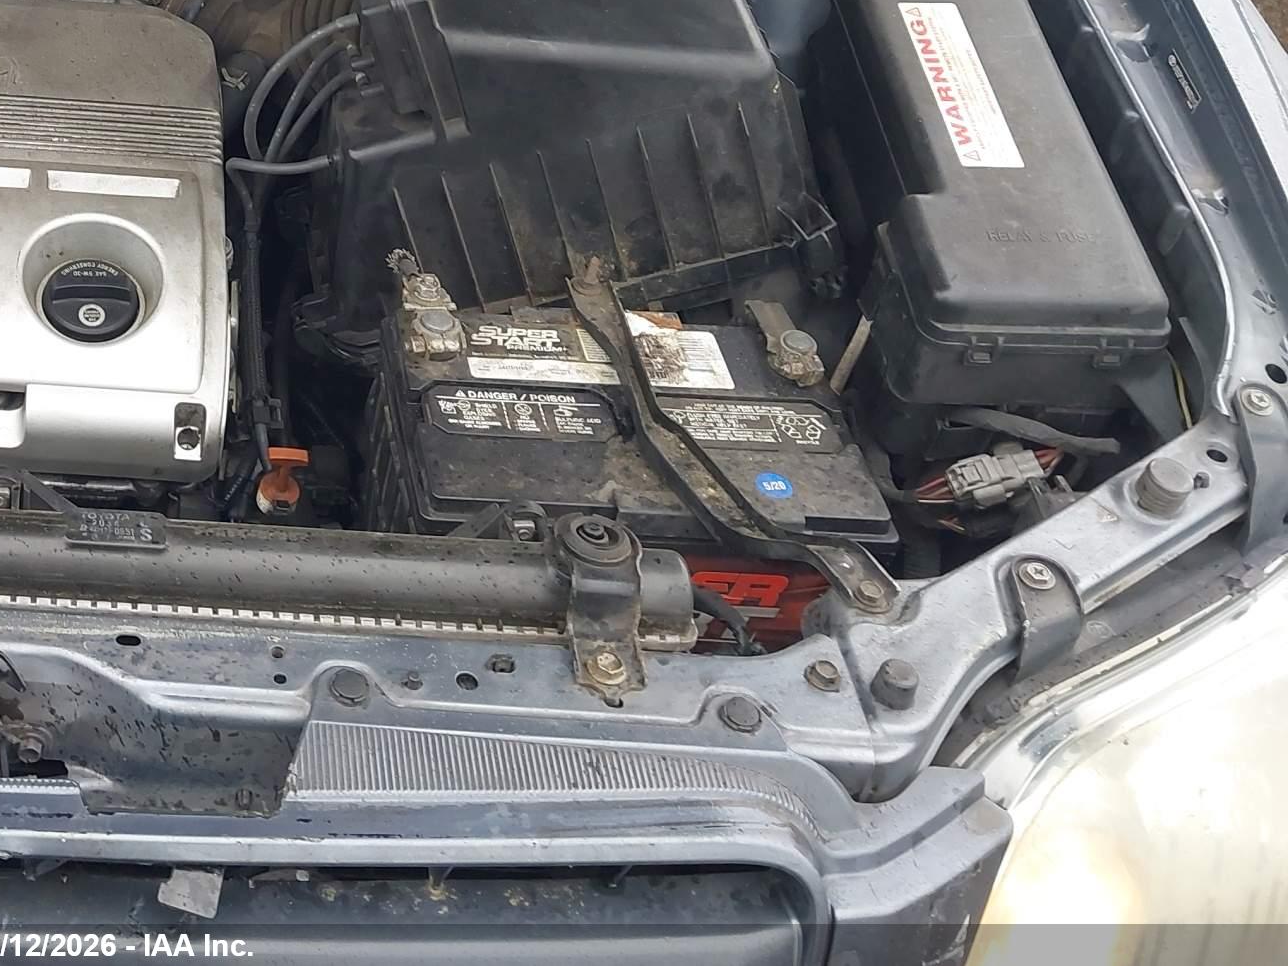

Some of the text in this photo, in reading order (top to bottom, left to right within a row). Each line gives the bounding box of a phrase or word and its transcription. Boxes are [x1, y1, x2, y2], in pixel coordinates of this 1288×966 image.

[909, 20, 972, 145] WARNING
[478, 325, 559, 338] SUPER
[470, 333, 561, 347] START
[467, 390, 575, 403] DANGER / POISON
[762, 480, 787, 491] 5/20
[82, 512, 130, 521] TOYOTA
